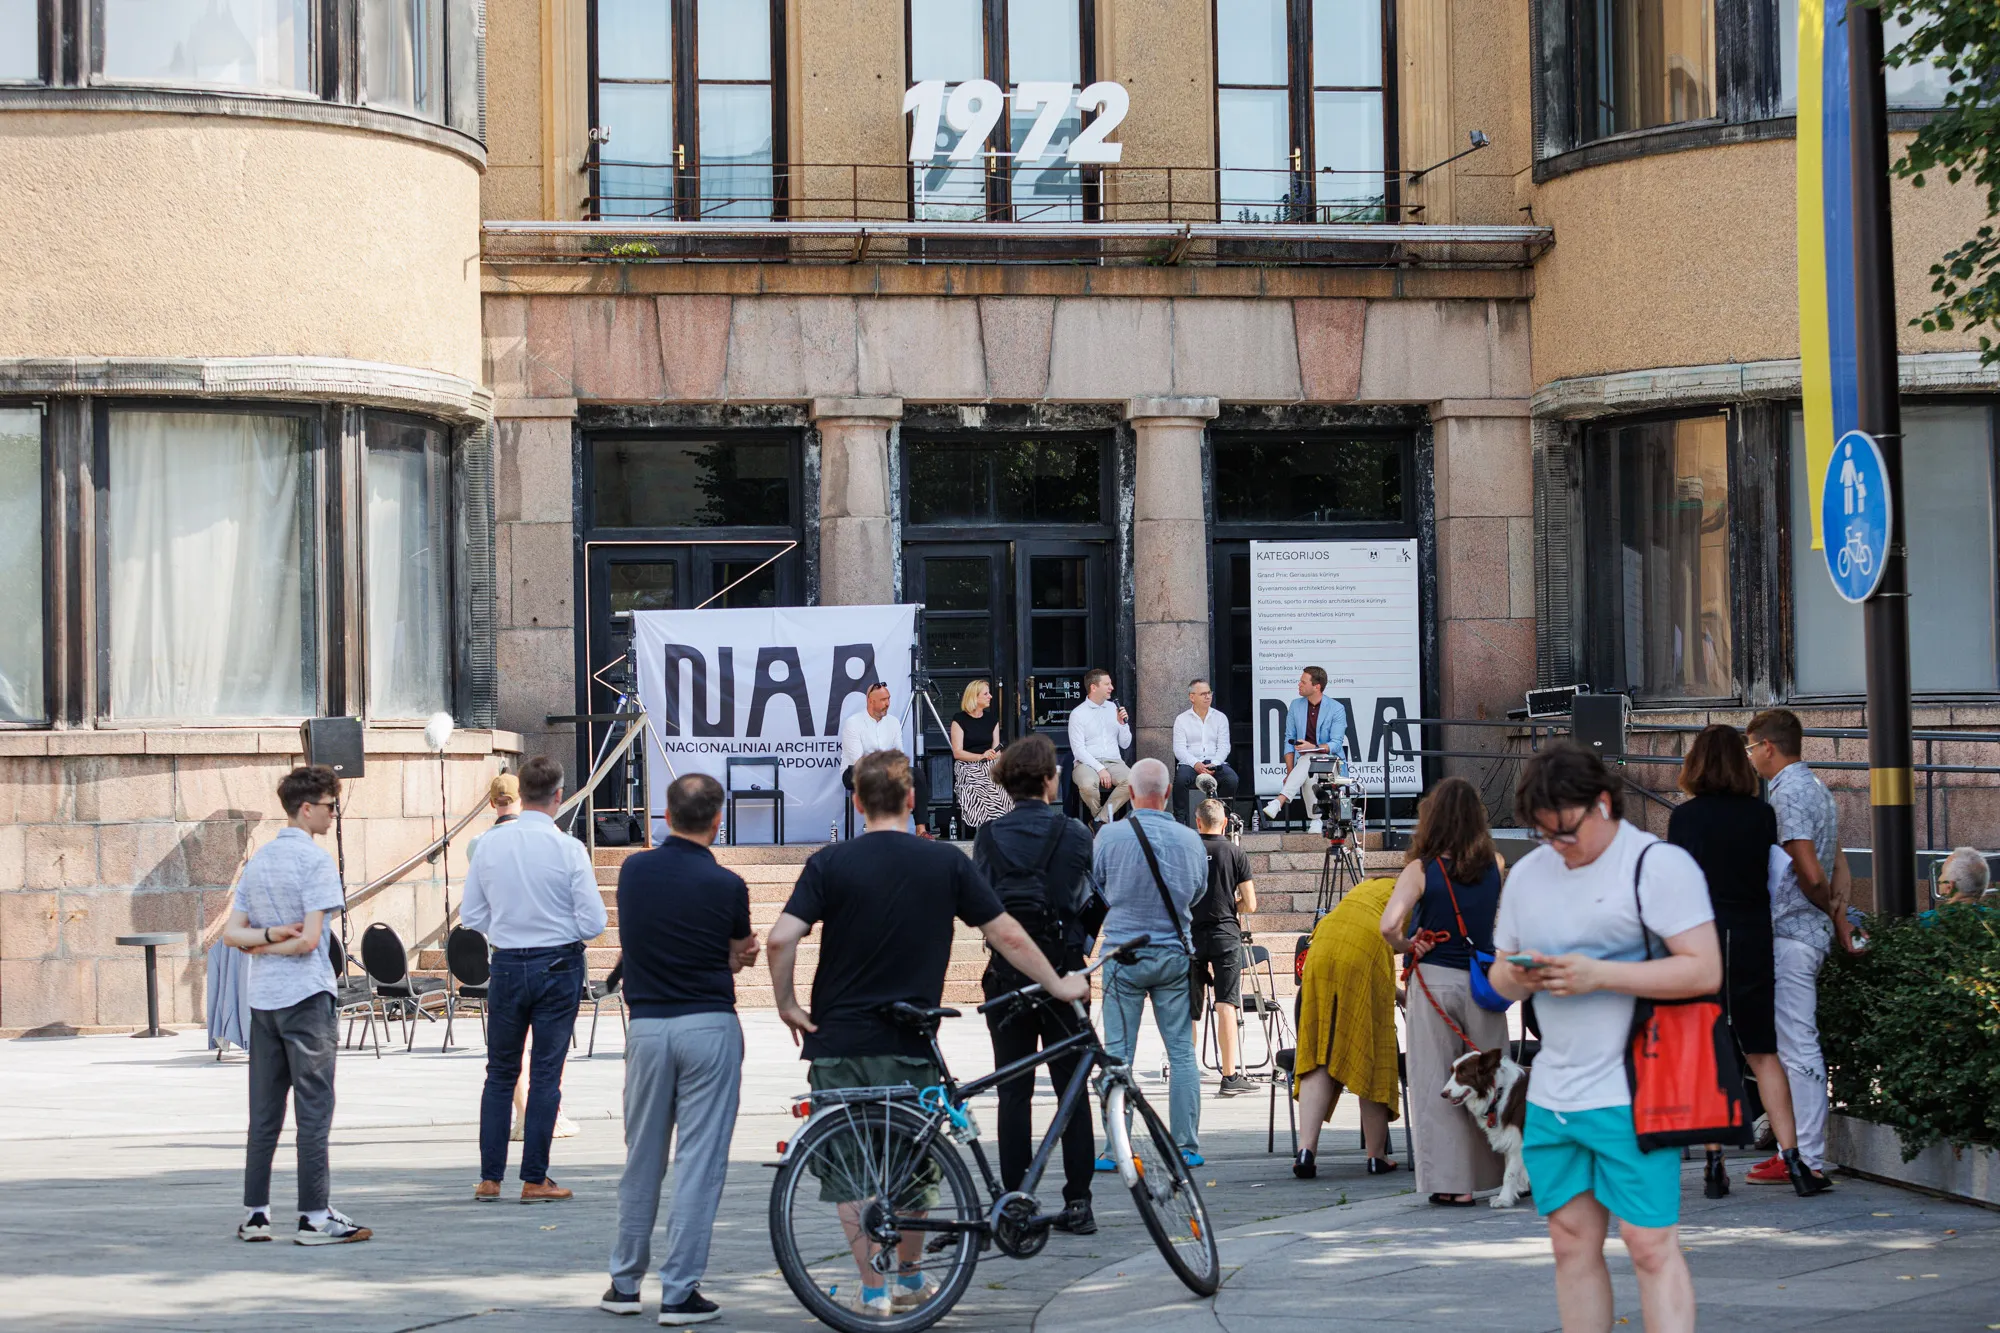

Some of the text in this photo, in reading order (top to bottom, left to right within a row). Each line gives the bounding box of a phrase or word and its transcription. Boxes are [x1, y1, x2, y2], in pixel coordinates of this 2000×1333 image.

[902, 79, 1130, 163] 1972
[1256, 551, 1330, 560] KATEGORIJOS
[665, 741, 842, 753] NACIONALINIAI ARCHITEK
[778, 757, 842, 768] APDOVAN
